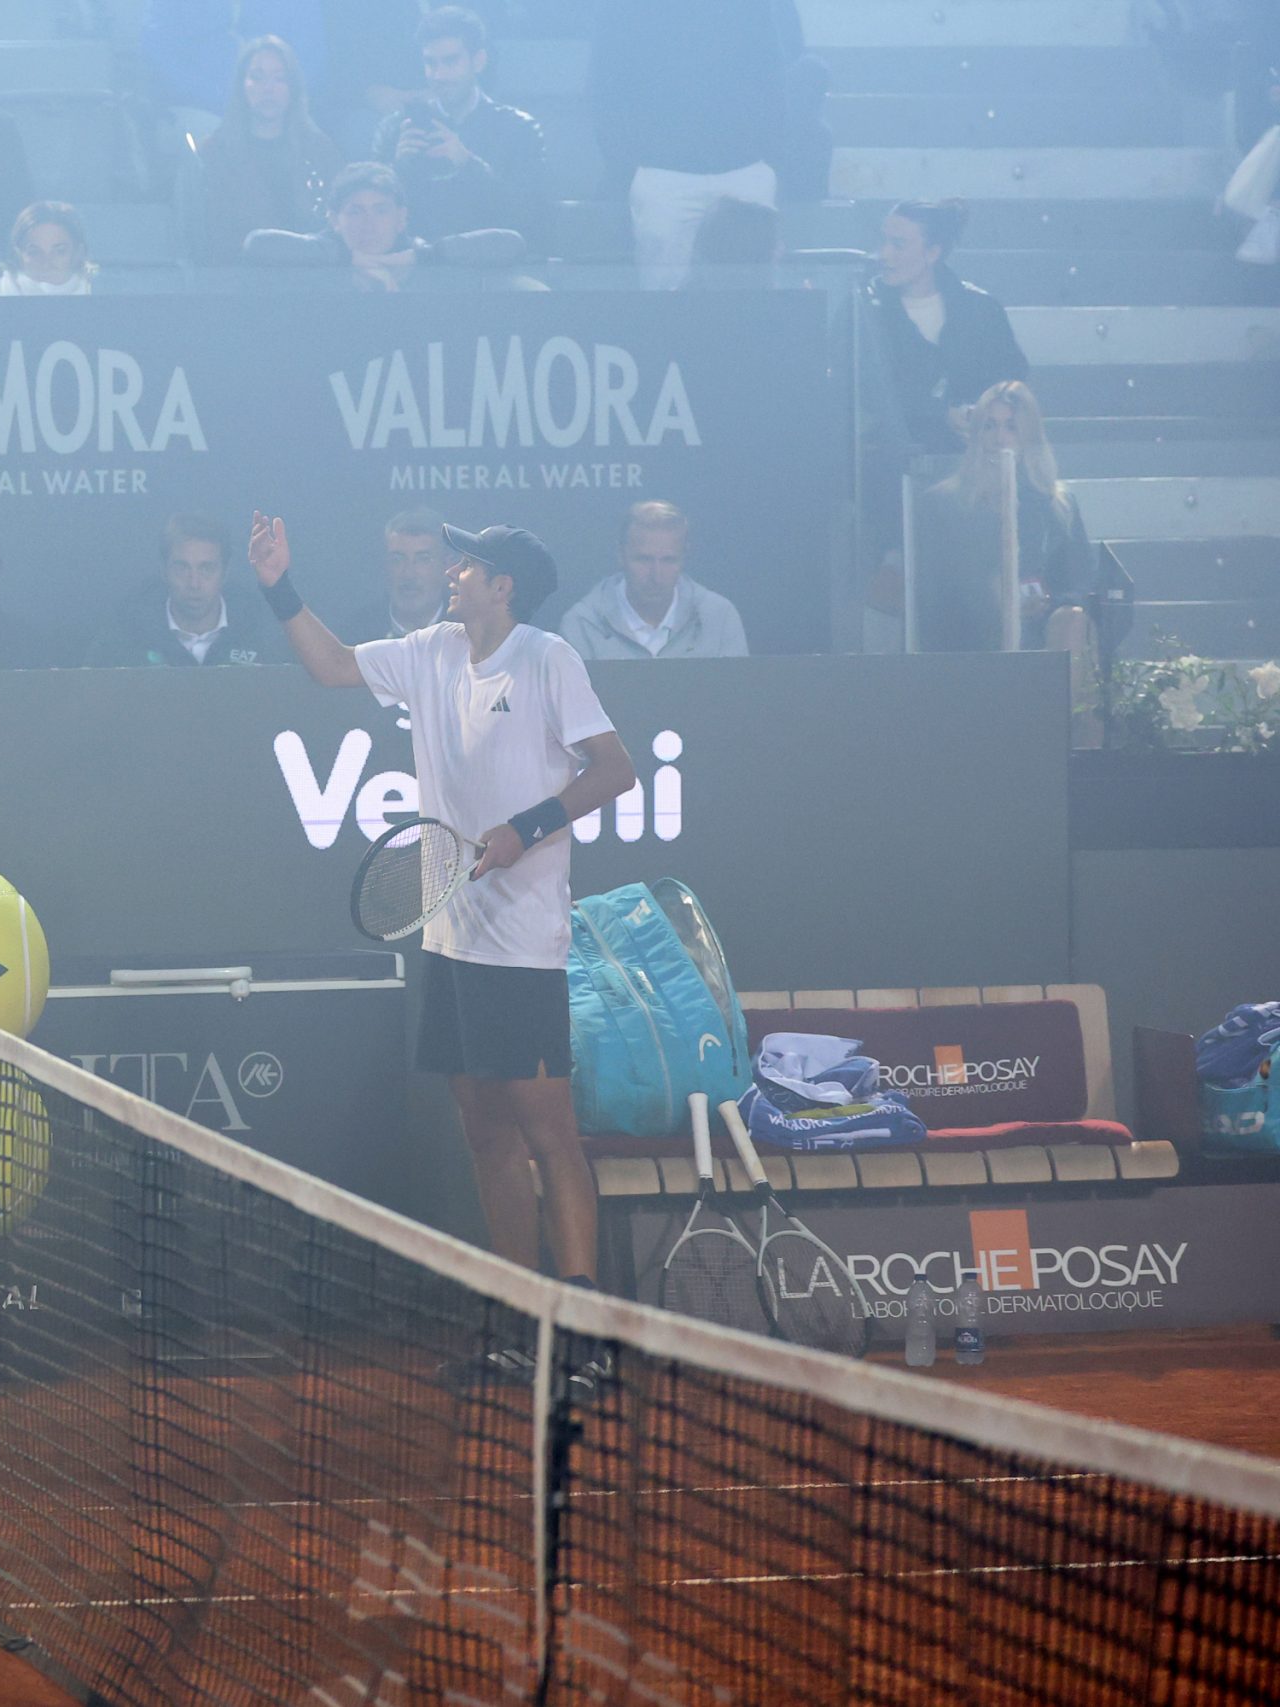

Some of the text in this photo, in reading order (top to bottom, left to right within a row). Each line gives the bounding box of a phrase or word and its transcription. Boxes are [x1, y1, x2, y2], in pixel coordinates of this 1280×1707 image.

[328, 335, 702, 450] VALMORA
[41, 469, 149, 494] WATER
[389, 463, 643, 490] MINERAL WATER
[876, 1055, 1040, 1087] ROCHE POSAY
[777, 1242, 1189, 1299] LA ROCHE POSAY
[987, 1289, 1164, 1315] DERMATOLOGIQUE
